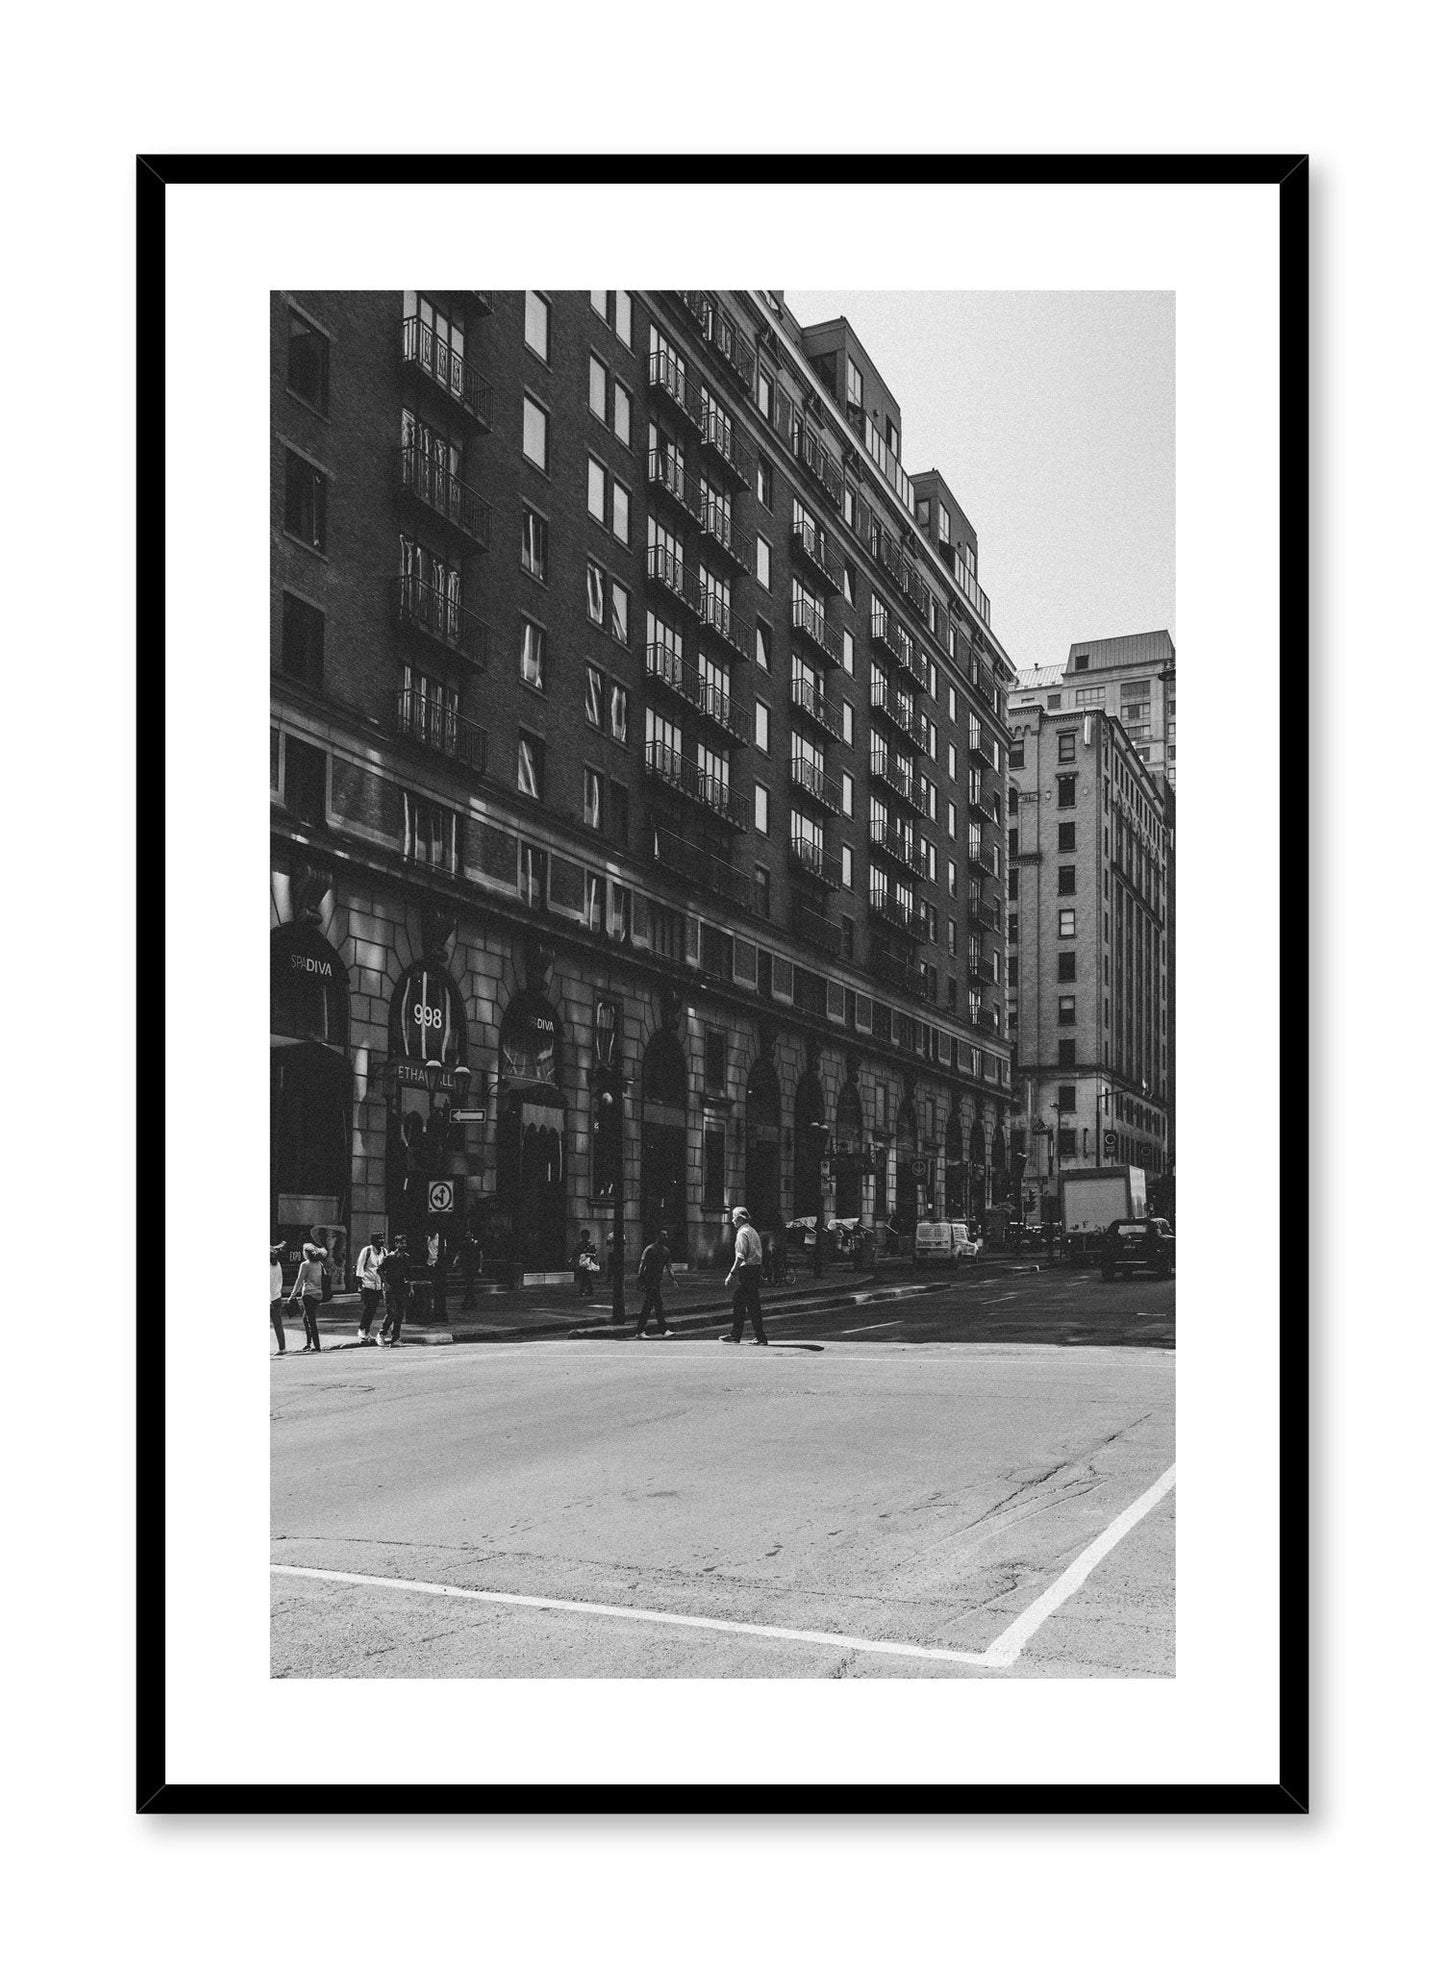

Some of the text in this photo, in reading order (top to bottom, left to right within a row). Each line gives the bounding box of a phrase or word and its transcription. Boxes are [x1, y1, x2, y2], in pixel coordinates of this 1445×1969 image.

[414, 1003, 442, 1029] 998
[528, 1015, 555, 1033] DIVA
[398, 1065, 426, 1082] ETHA
